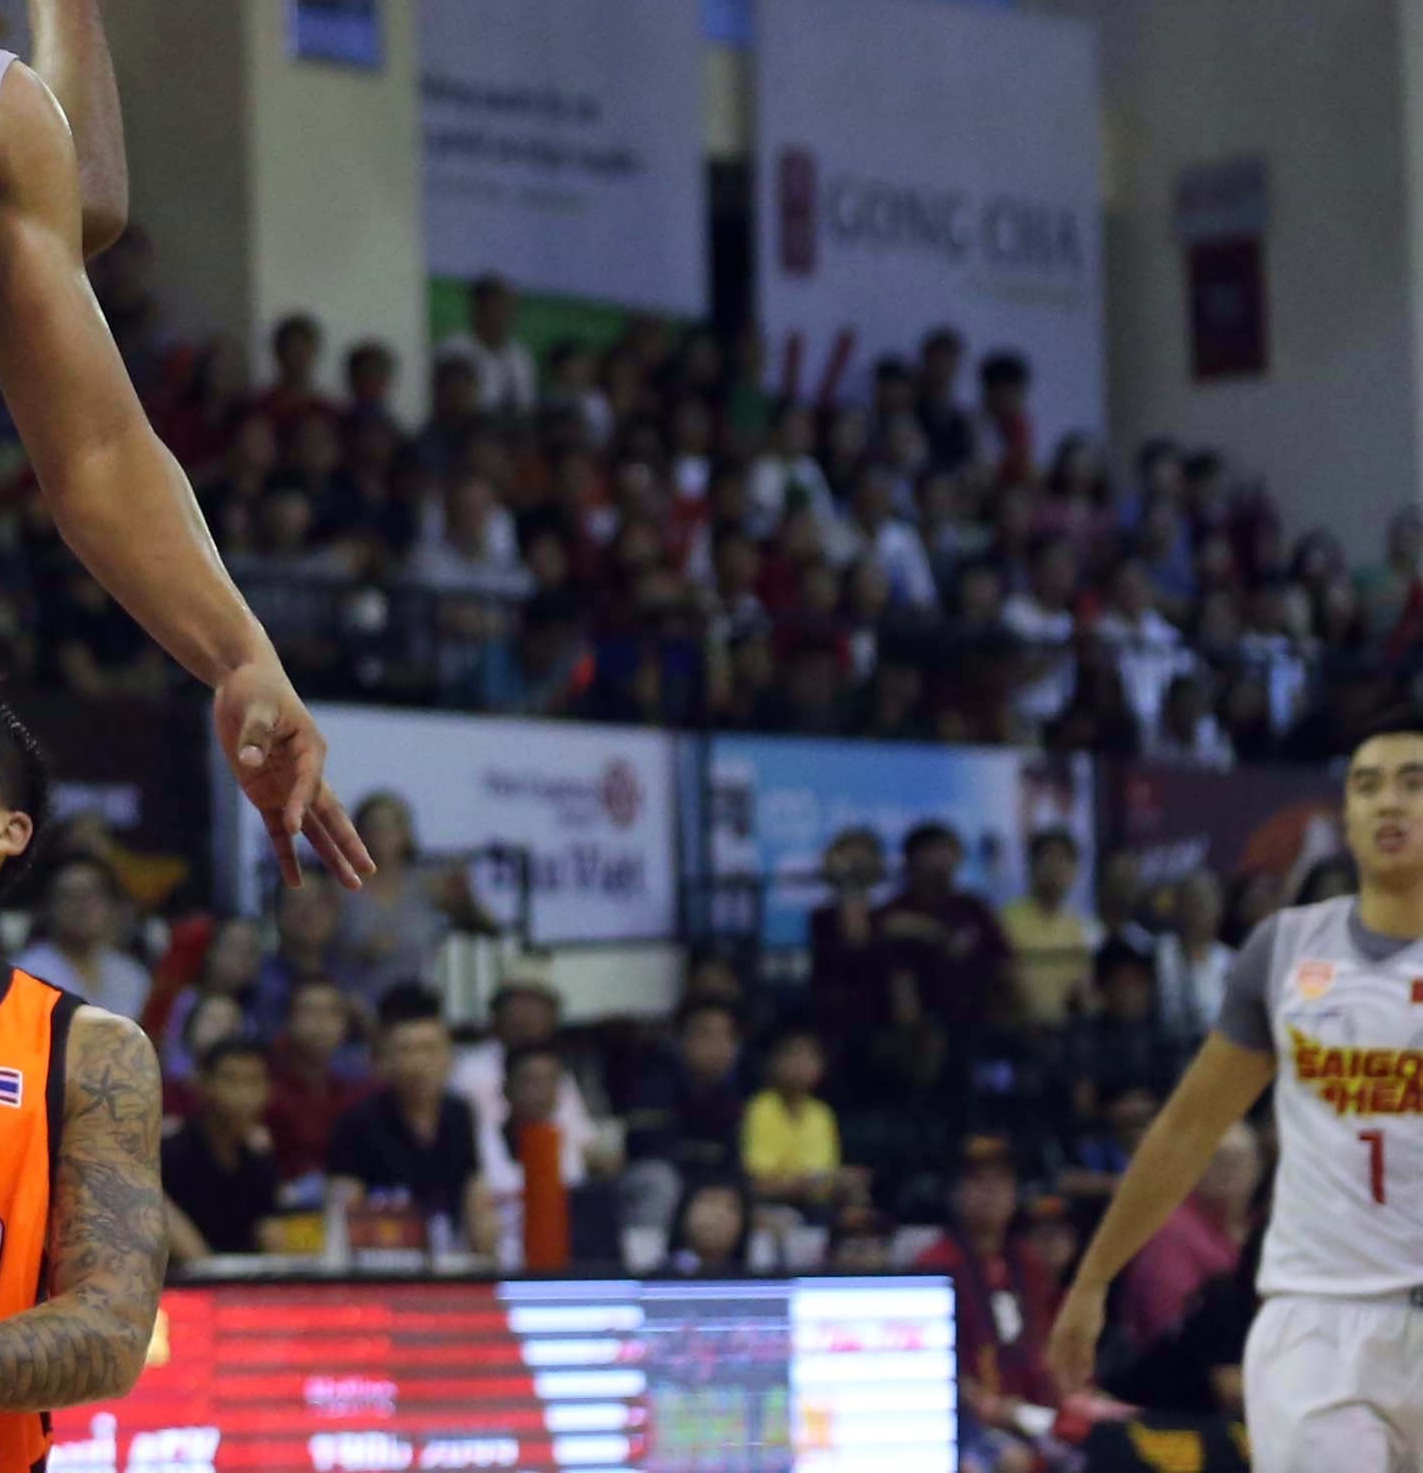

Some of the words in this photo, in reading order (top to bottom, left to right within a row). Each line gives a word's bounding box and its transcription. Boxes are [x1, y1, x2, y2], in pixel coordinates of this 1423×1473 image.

[1295, 1044, 1423, 1082] SAIGO
[1334, 1079, 1423, 1116] HEA
[1358, 1130, 1387, 1205] 1
